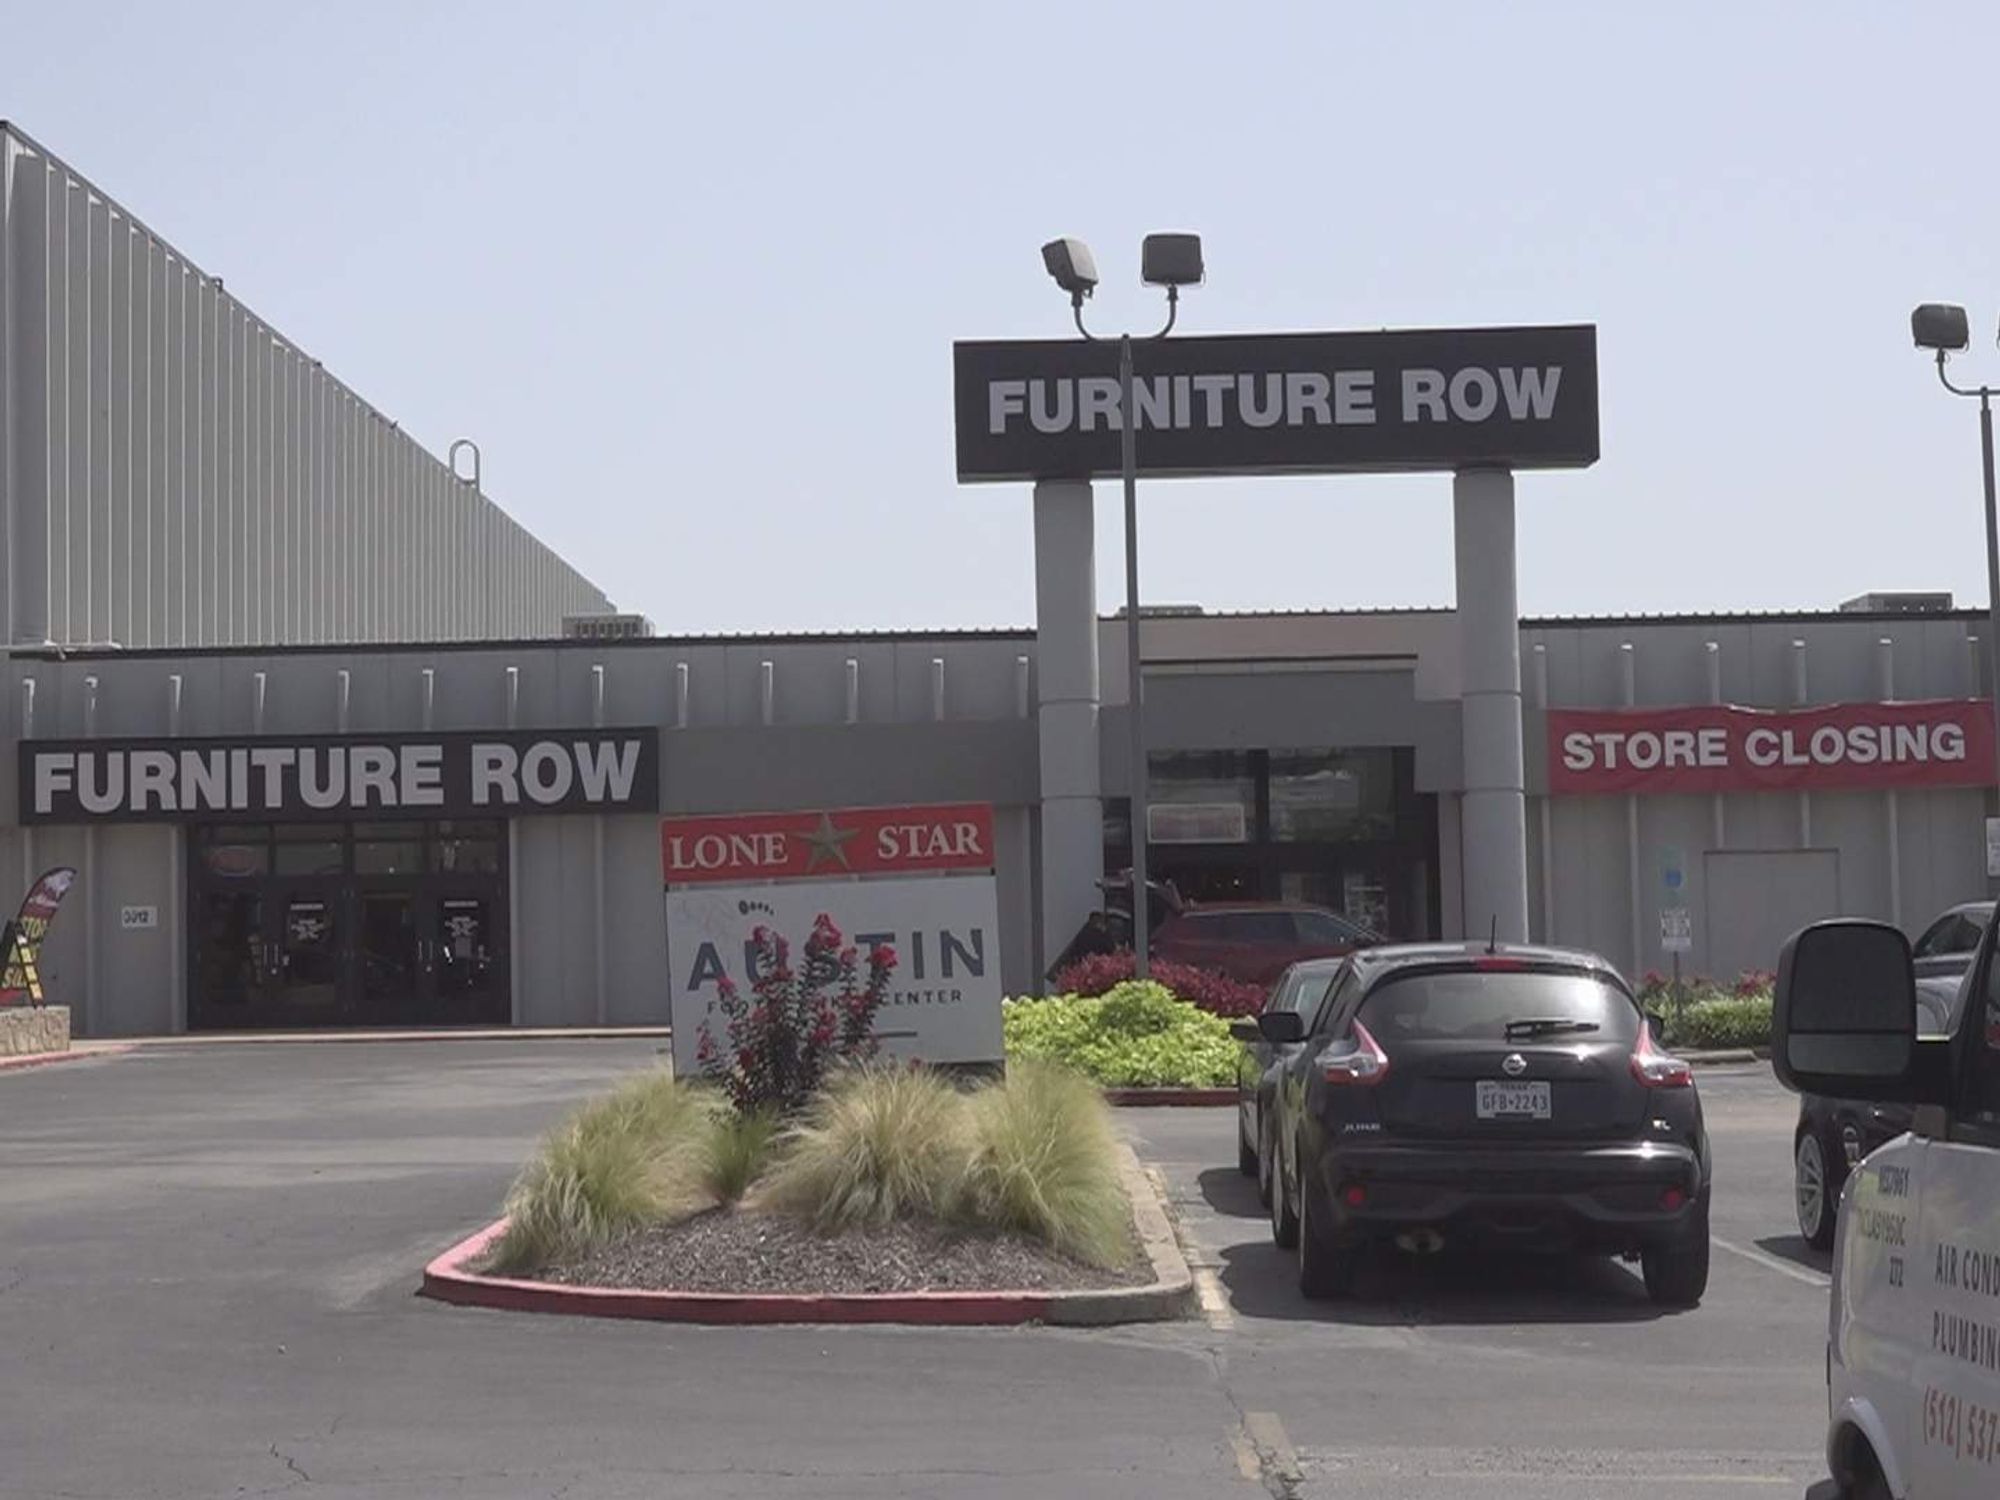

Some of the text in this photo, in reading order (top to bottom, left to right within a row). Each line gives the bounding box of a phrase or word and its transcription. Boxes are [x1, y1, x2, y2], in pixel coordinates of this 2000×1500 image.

[988, 365, 1563, 435] FURNITURE ROW
[34, 740, 642, 814] FURNITURE ROW
[1562, 722, 1966, 771] STORE CLOSING
[669, 821, 984, 870] LONE STAR
[1934, 1243, 1958, 1288] AIR
[1932, 1310, 2000, 1373] PLUMBIN
[1923, 1384, 1963, 1461] (512)
